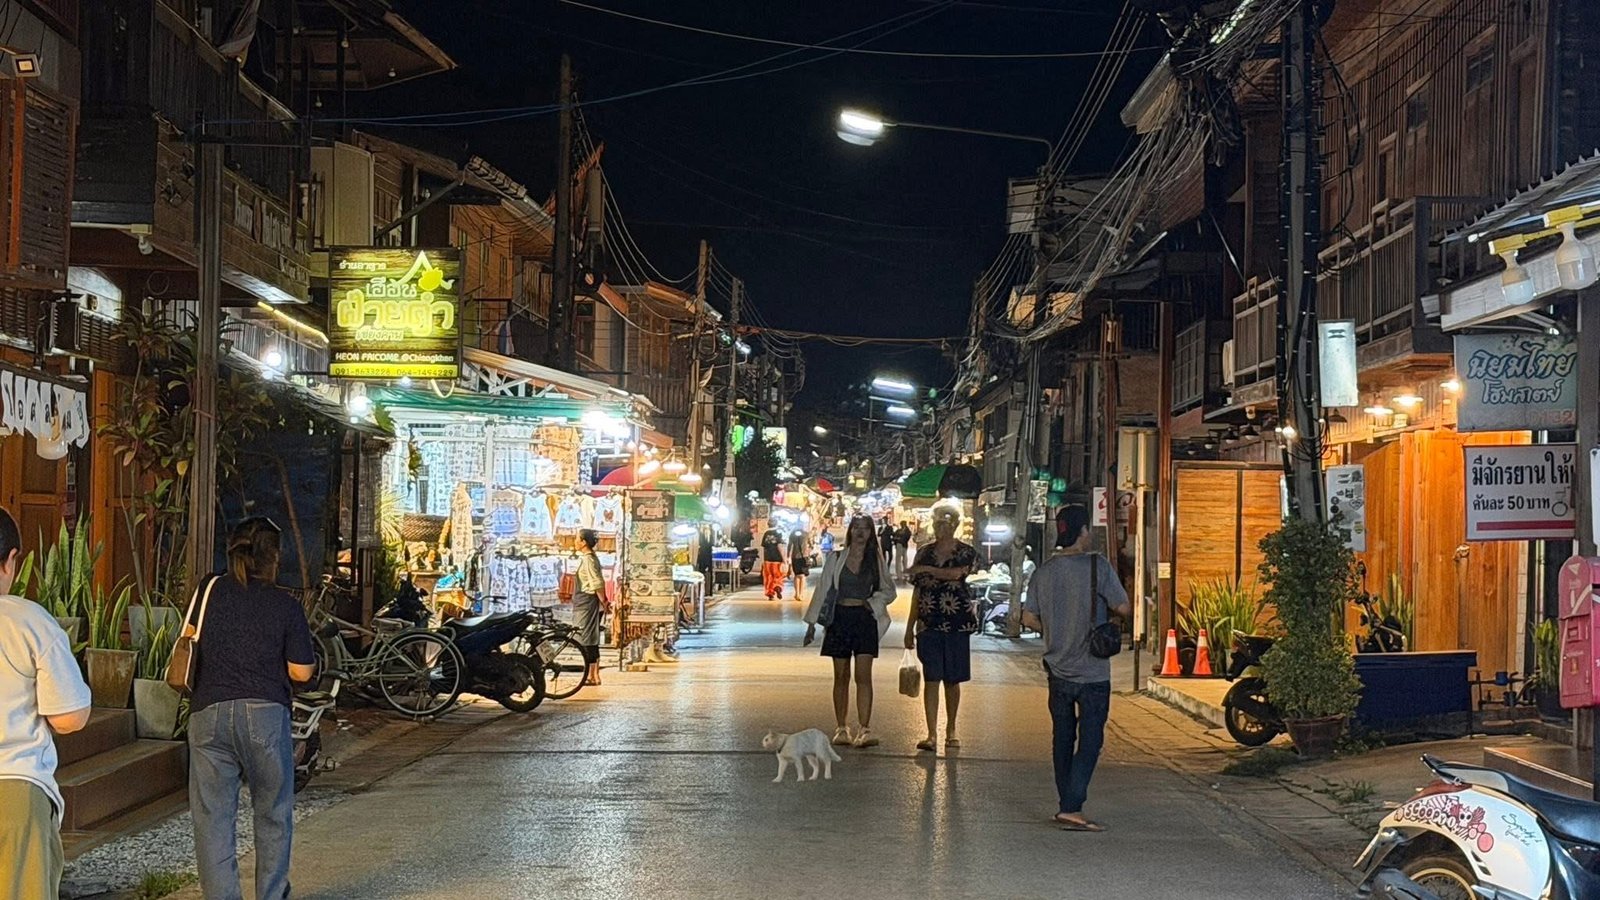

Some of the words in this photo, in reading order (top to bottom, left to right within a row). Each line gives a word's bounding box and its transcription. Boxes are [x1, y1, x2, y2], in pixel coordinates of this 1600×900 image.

[339, 260, 387, 271] ร้านอาหาร
[355, 326, 404, 341] เชียงคาน
[335, 352, 360, 361] HEON
[1472, 494, 1504, 511] คันละ
[1507, 495, 1525, 510] 50
[1527, 498, 1551, 510] บาท
